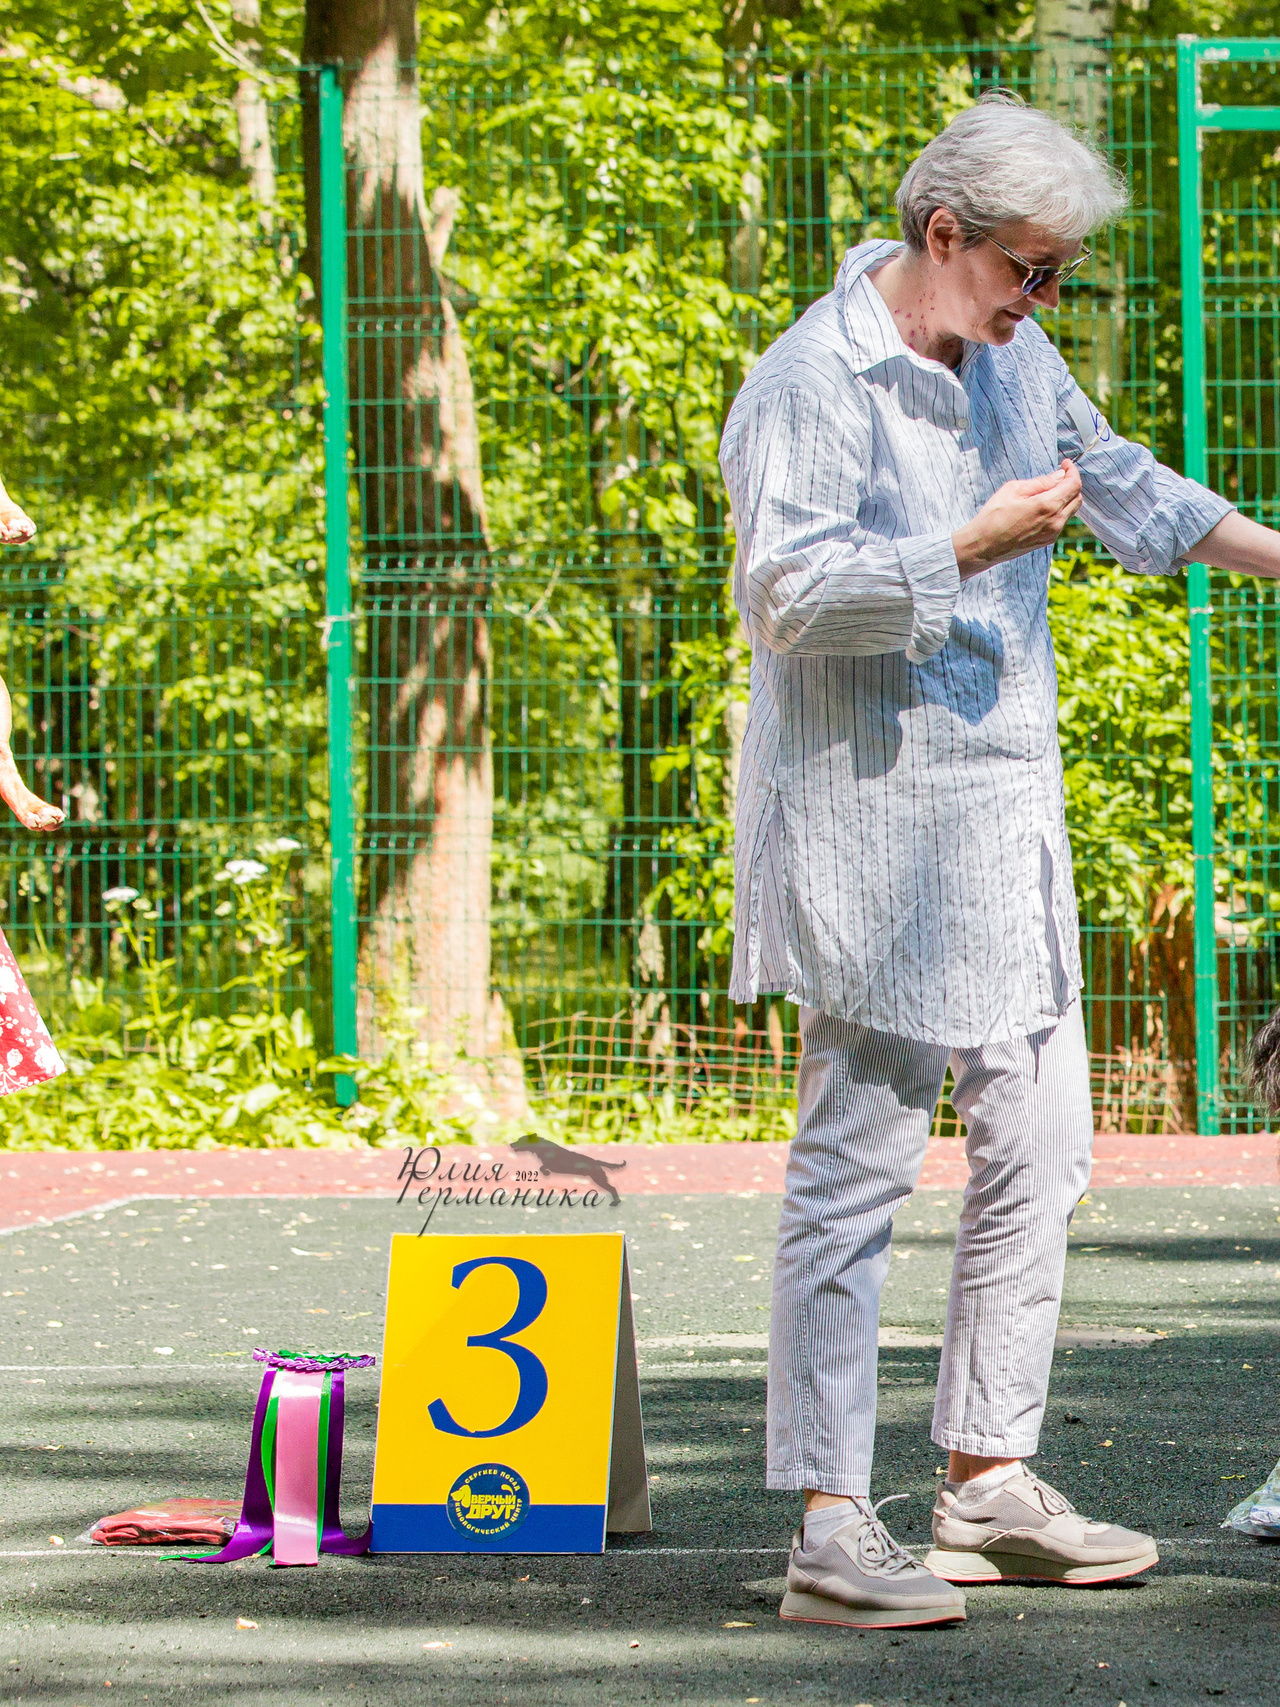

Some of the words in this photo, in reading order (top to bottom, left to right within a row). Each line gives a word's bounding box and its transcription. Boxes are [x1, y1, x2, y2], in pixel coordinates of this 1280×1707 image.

[427, 1256, 548, 1438] 3
[464, 1469, 498, 1484] СЕРГИЕВ
[501, 1471, 521, 1492] ПОСАД
[471, 1494, 517, 1505] ВЕРНЫЙ
[454, 1502, 509, 1534] КИНОЛОГИЧЕСКИЙ
[509, 1498, 523, 1523] ЦЕНТР
[465, 1504, 516, 1520] ДРУГ
